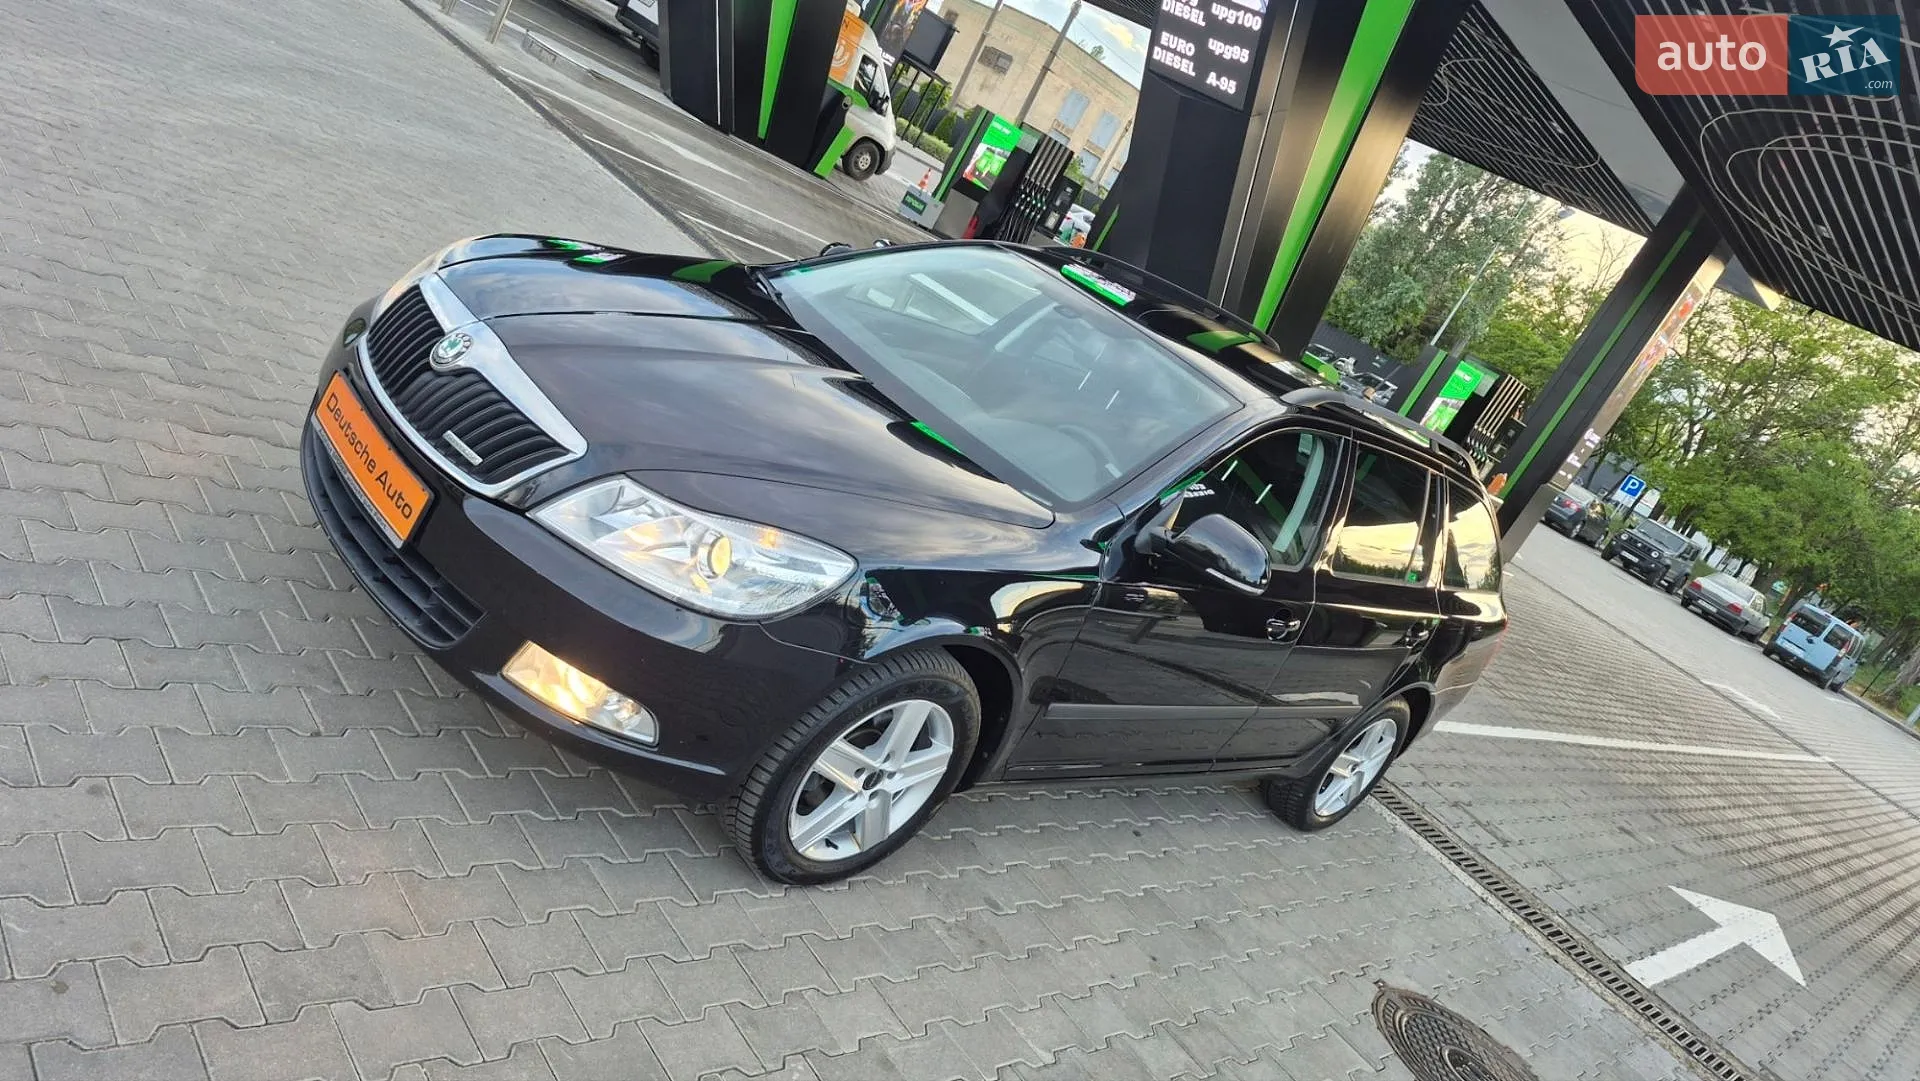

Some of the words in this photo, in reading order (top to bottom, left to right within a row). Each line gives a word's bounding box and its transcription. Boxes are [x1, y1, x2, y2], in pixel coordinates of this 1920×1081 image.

[1161, 0, 1206, 27] DIESEL
[1212, 3, 1262, 31] upg100
[1160, 31, 1196, 57] EURO
[1207, 37, 1250, 64] upg95
[1152, 45, 1196, 77] DIESEL
[1205, 71, 1237, 95] A-95
[325, 391, 377, 475] Deutsche
[375, 469, 413, 520] Auto
[1625, 479, 1639, 492] P
